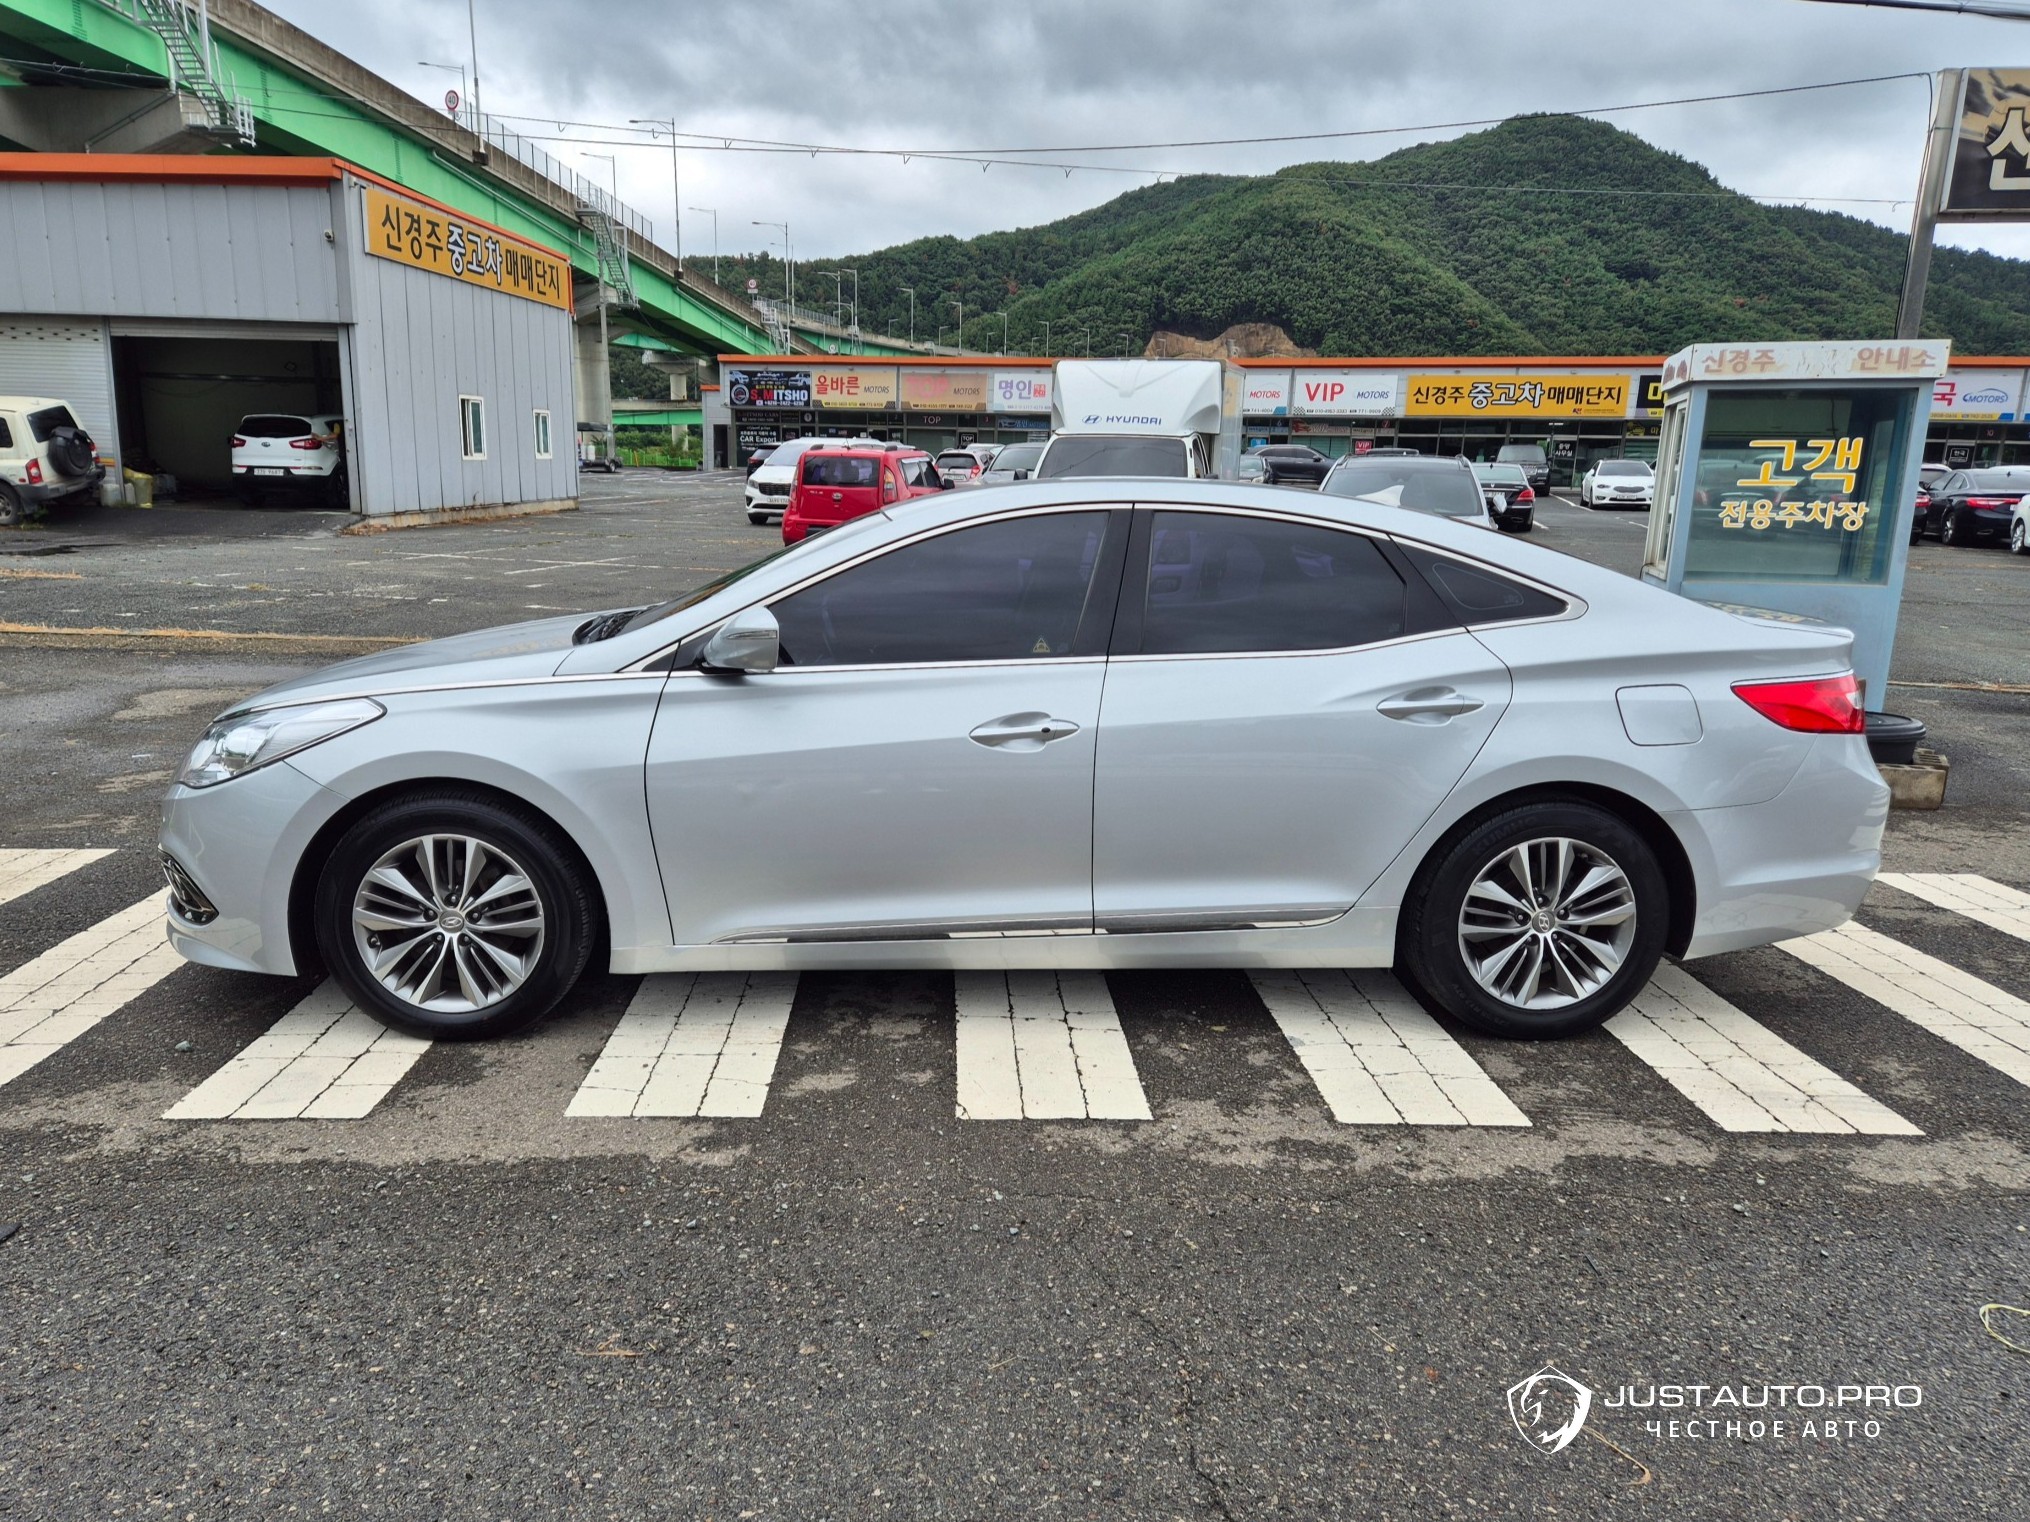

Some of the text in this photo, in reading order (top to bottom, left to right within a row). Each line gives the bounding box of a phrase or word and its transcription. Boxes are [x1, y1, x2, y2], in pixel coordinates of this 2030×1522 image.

[381, 204, 560, 300] 신경주 중고차 매매단지
[1701, 348, 1776, 374] 신경주
[1857, 346, 1936, 372] 안내소
[815, 374, 890, 395] 올바른 MOTORS
[953, 387, 980, 396] MOTORS
[998, 379, 1032, 400] 명인
[1249, 390, 1281, 399] MOTORS
[1305, 383, 1390, 402] VIP MOTORS
[1413, 381, 1622, 409] 신경주 중고차 매매단지
[1968, 395, 2005, 404] MOTORS
[922, 415, 941, 424] TOP
[1105, 415, 1162, 425] HYUNDAI
[1736, 437, 1864, 494] 고객
[1718, 499, 1870, 532] 전용주차장
